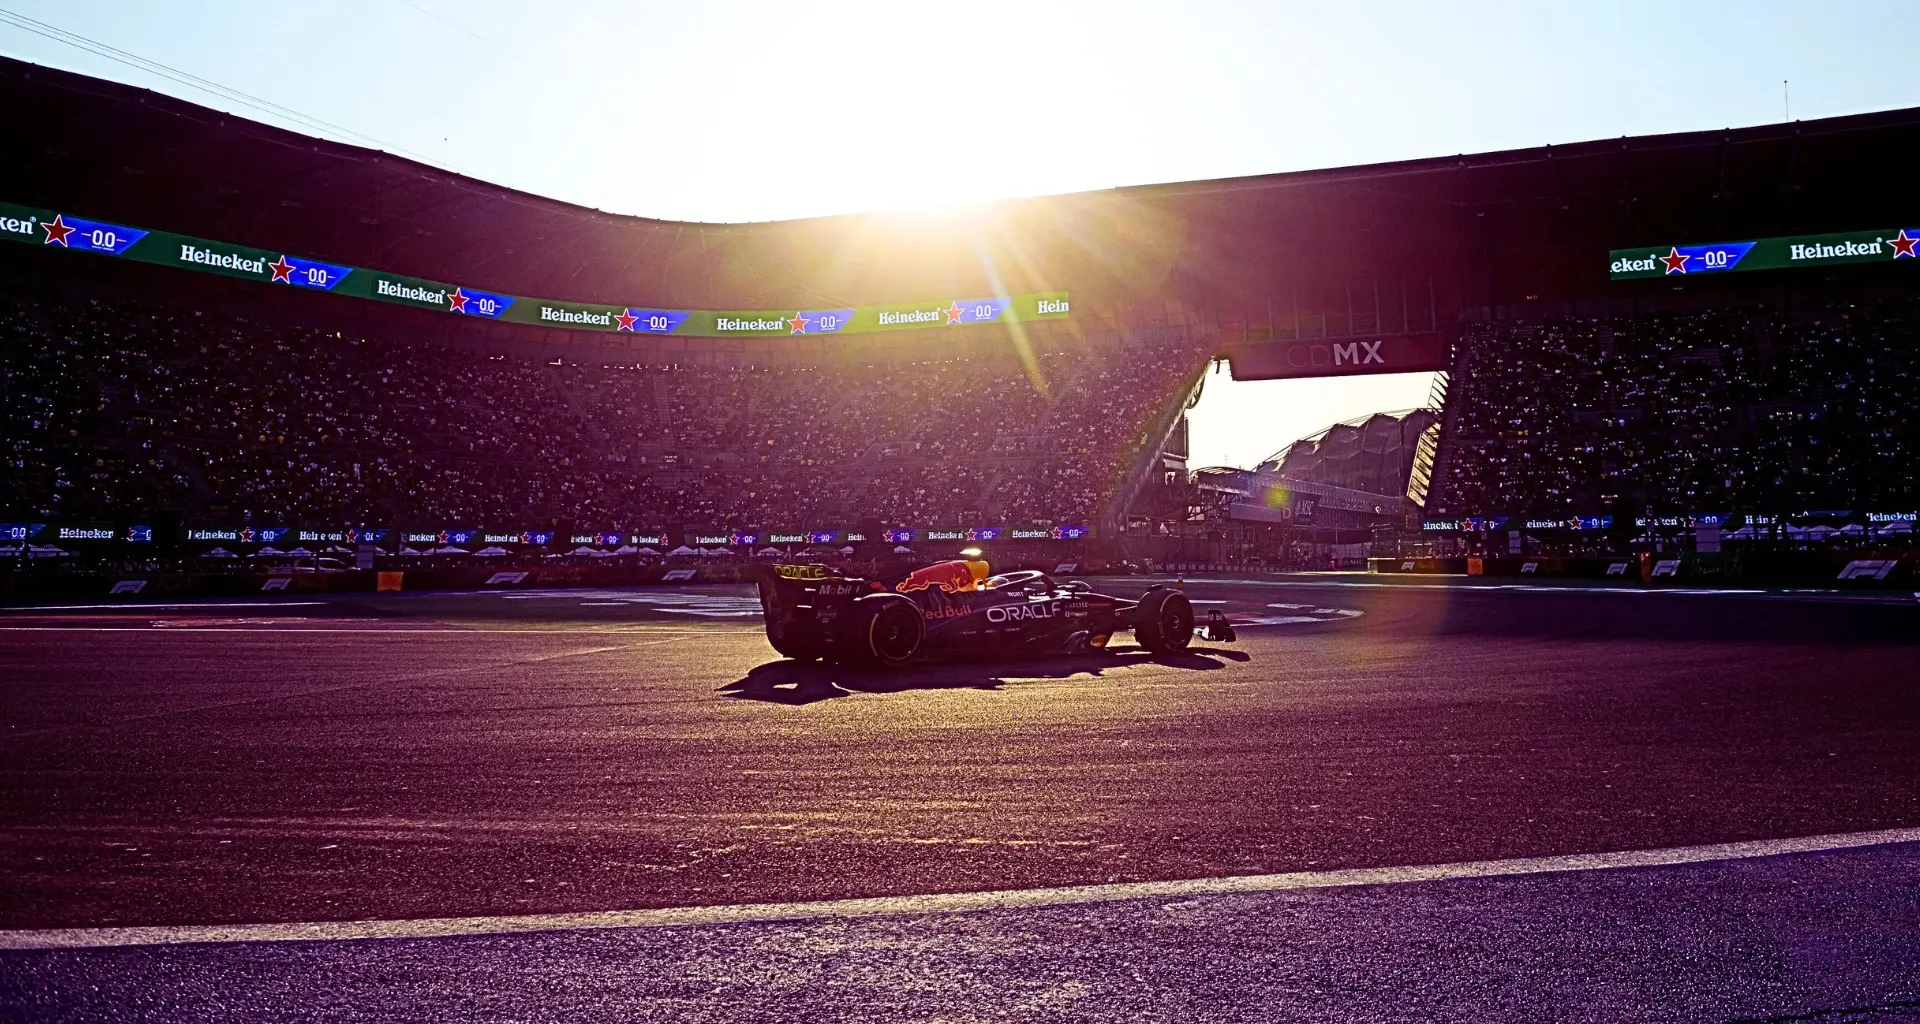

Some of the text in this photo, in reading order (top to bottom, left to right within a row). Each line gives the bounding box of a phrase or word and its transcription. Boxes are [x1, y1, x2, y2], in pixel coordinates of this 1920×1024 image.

[180, 245, 263, 273] Heineken
[1790, 241, 1883, 260] Heineken
[1610, 257, 1656, 273] eken
[377, 280, 444, 304] Heineken
[541, 307, 610, 325] Heineken
[716, 317, 783, 331] Heineken
[878, 310, 940, 325] Heineken
[818, 584, 852, 595] Mobil
[986, 601, 1061, 623] ORACLE
